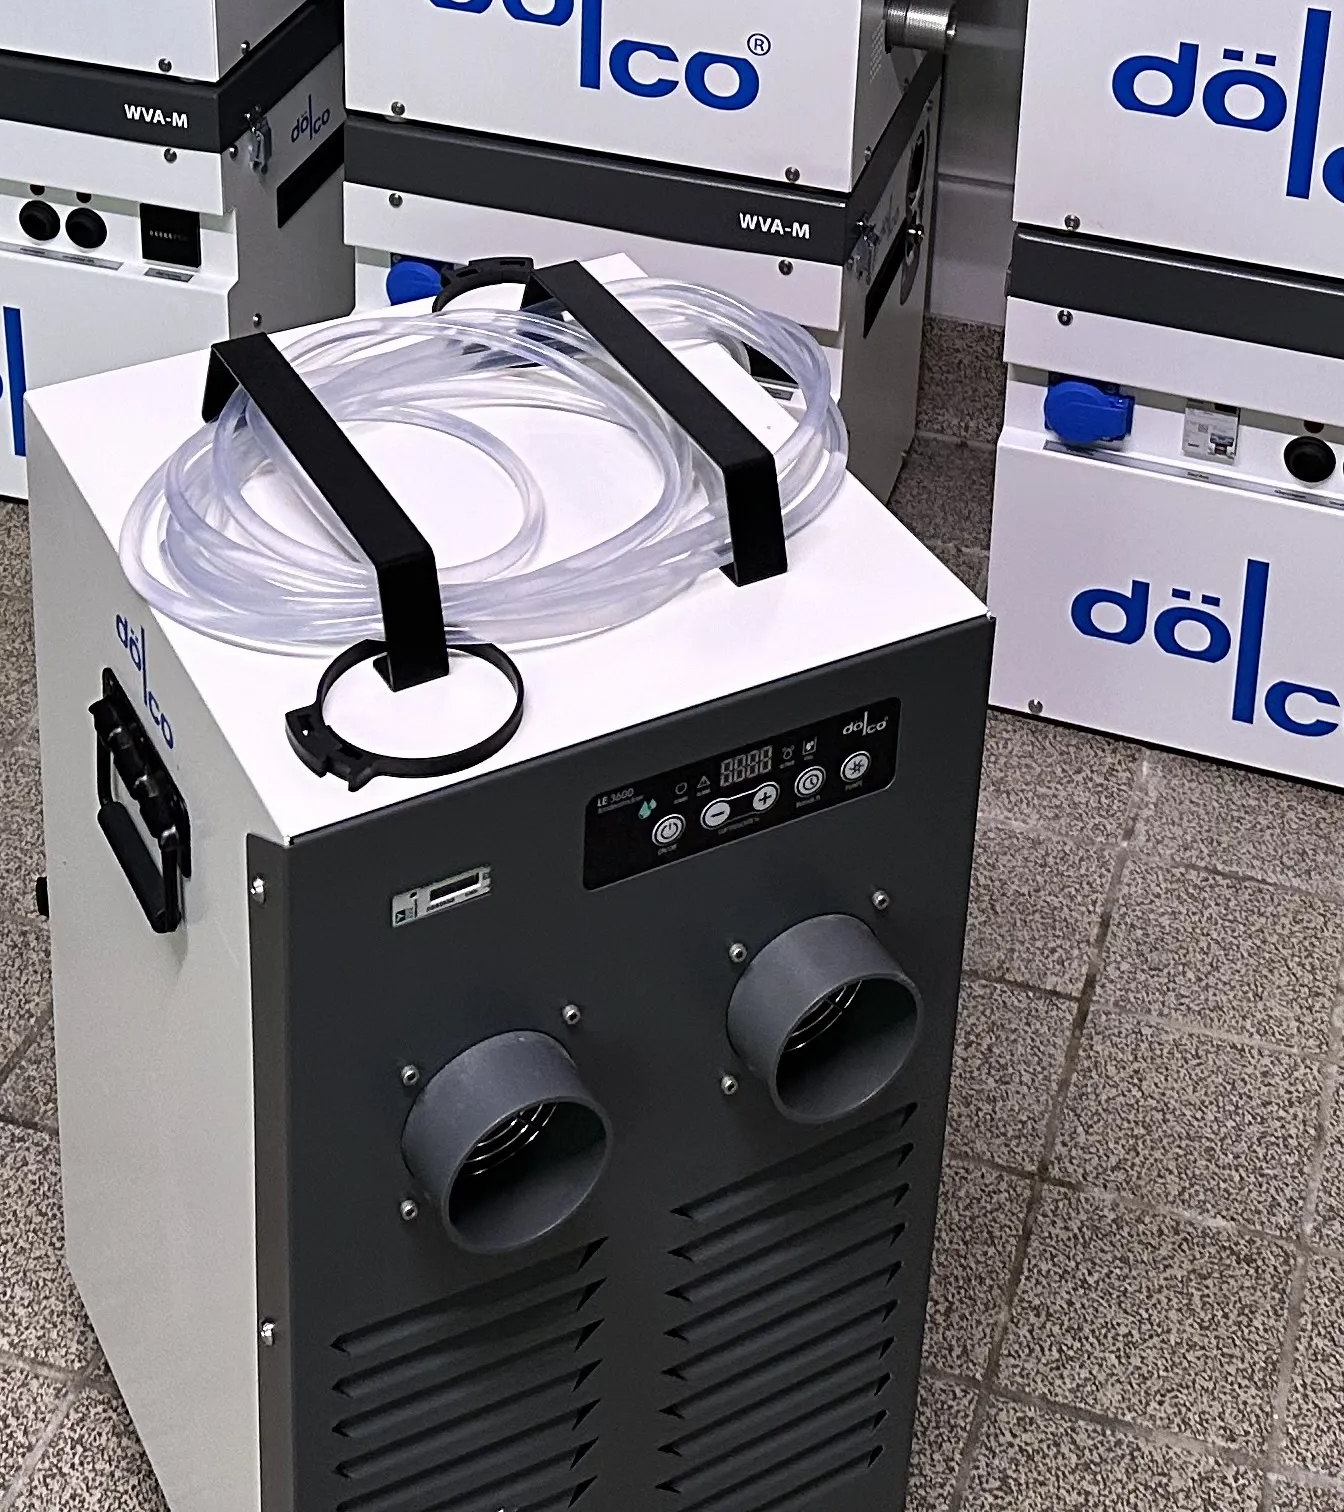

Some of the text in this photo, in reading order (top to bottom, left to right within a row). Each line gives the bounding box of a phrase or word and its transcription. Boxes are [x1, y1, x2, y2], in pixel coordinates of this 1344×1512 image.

[124, 104, 187, 128] WVA-M
[291, 93, 331, 143] dölco
[740, 213, 809, 239] WVA-M
[116, 614, 174, 749] dölco
